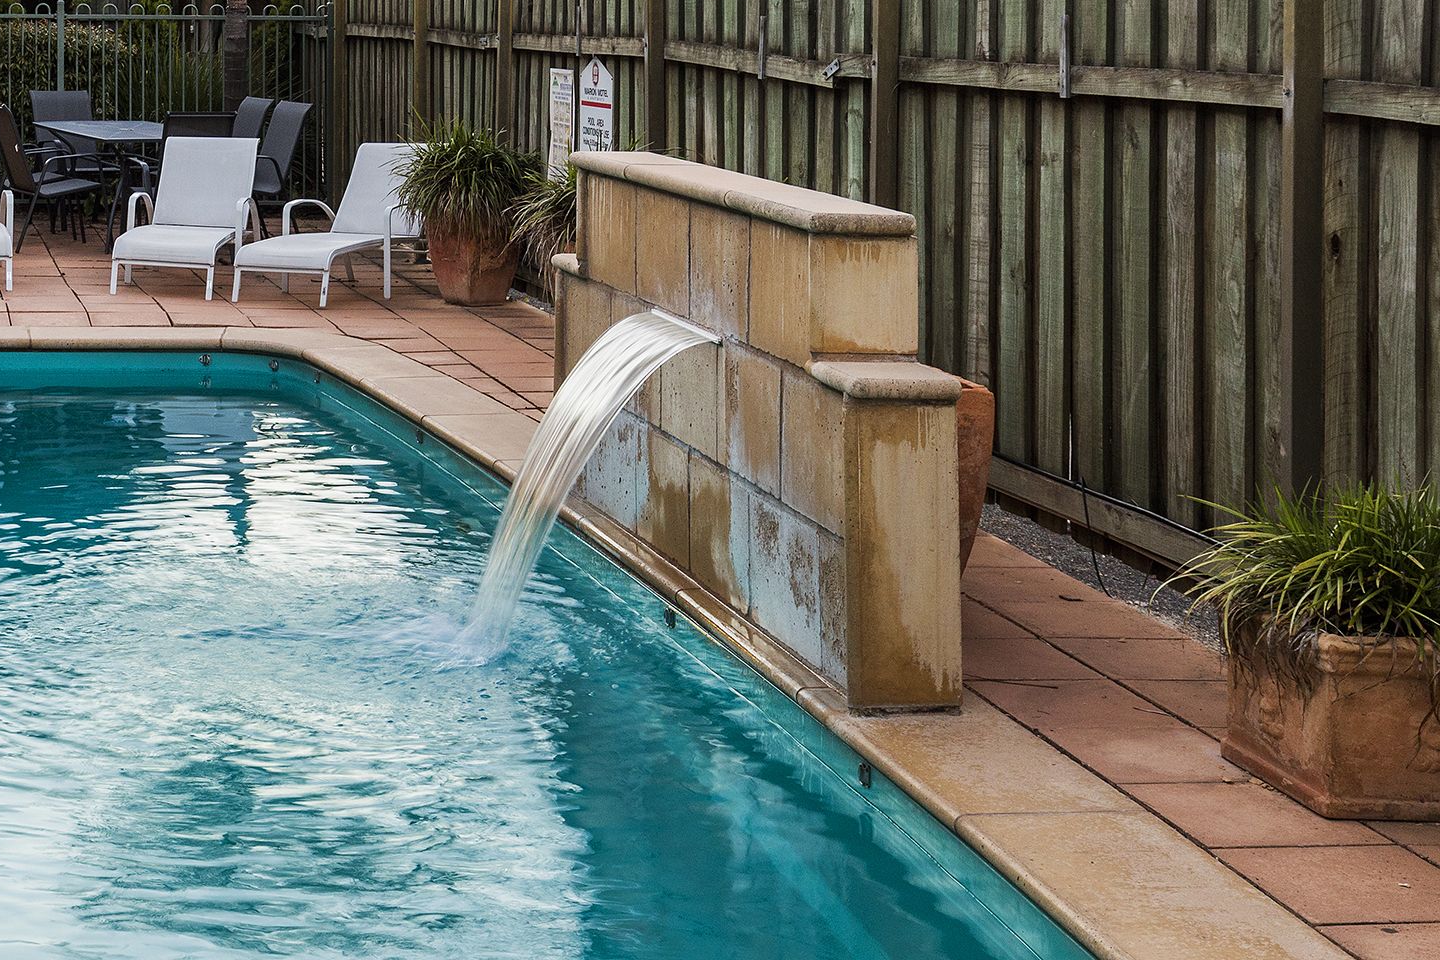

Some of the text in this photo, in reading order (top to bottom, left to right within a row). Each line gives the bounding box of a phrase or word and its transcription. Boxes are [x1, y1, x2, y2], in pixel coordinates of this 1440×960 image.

[597, 89, 609, 98] MOTEL
[587, 117, 604, 127] POOL AREA
